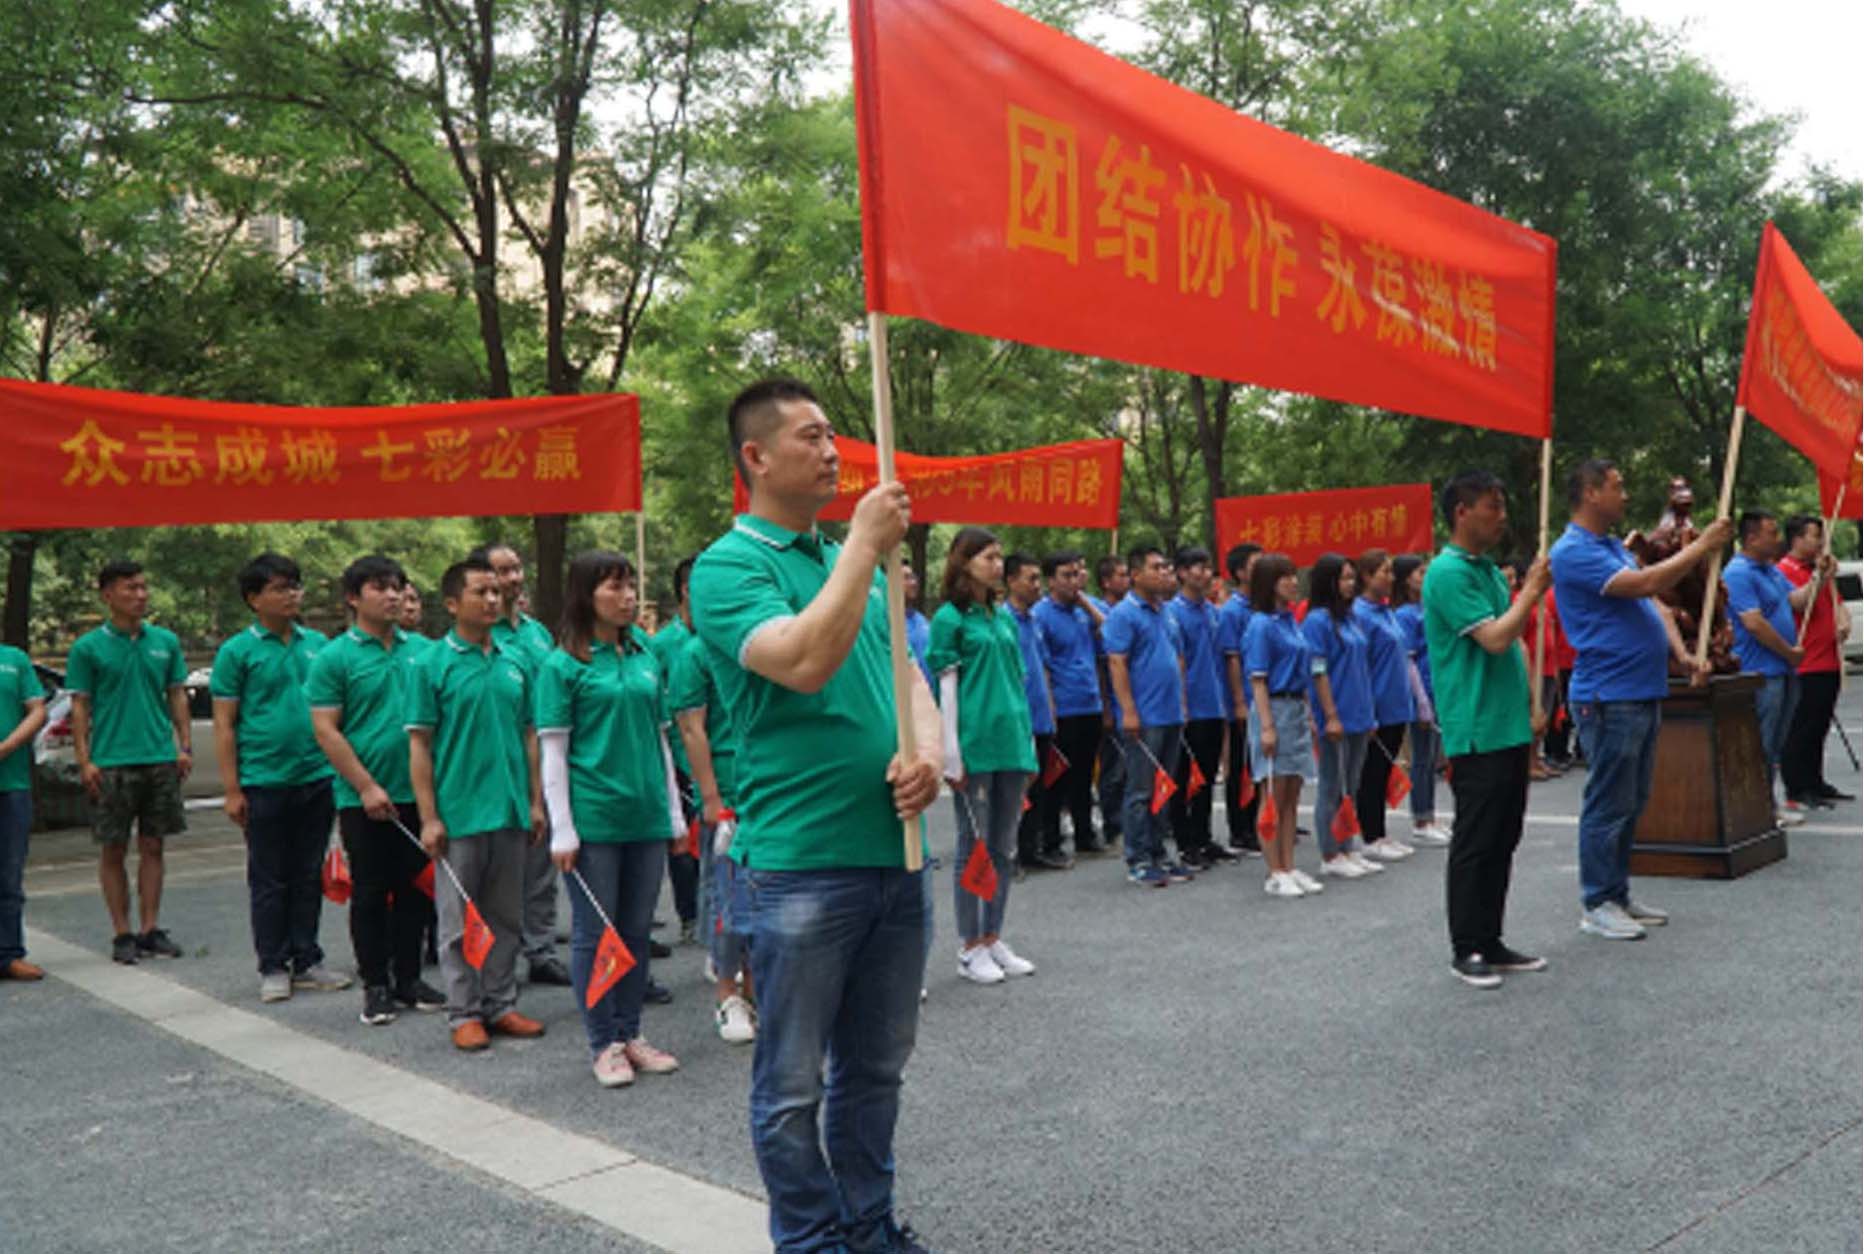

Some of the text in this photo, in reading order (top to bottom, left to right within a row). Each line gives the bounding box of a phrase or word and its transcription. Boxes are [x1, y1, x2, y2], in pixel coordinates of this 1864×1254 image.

[1006, 103, 1297, 319] 团结协作
[60, 418, 583, 488] 众志成城 七彩必赢
